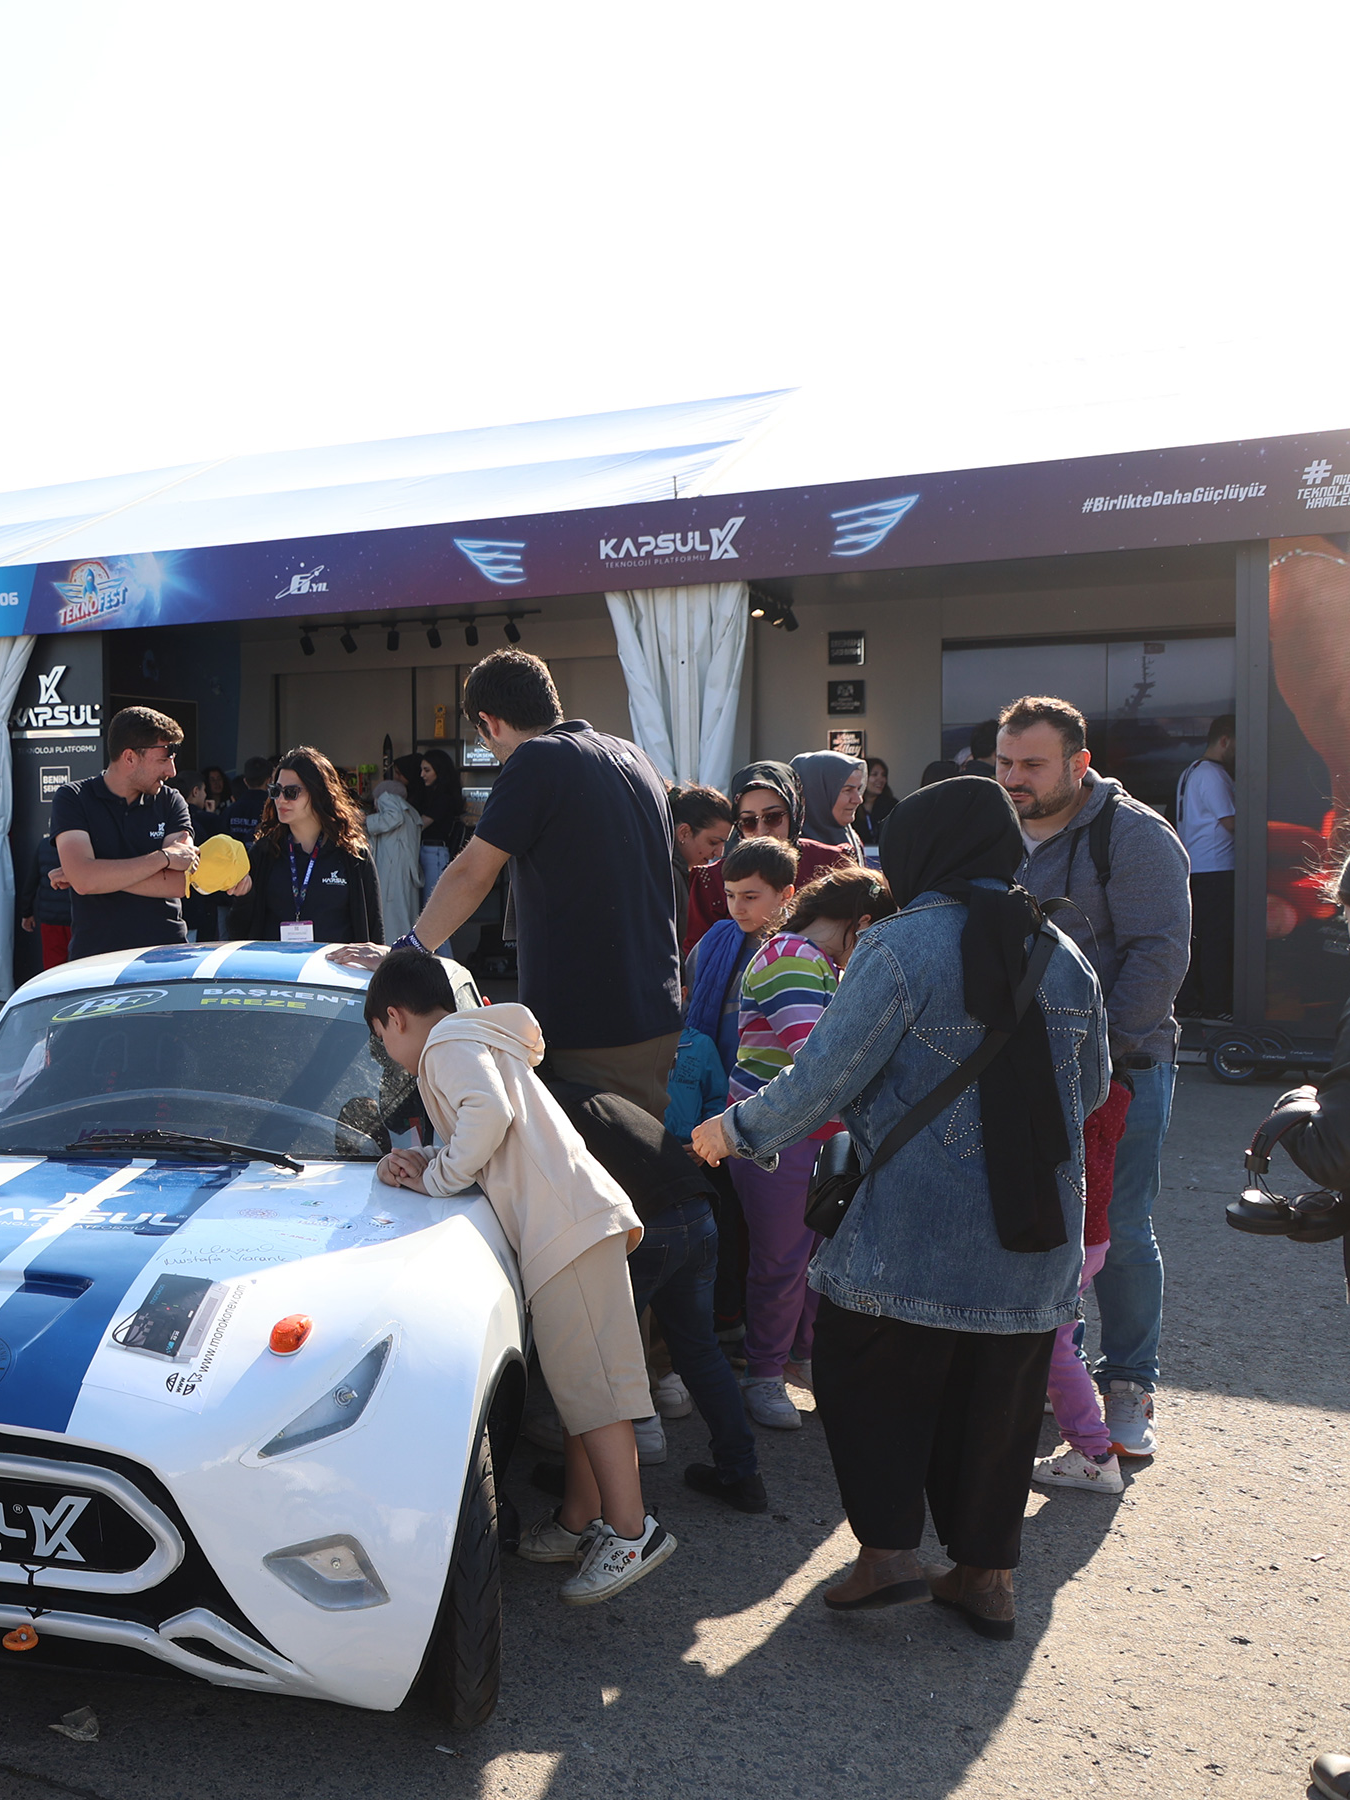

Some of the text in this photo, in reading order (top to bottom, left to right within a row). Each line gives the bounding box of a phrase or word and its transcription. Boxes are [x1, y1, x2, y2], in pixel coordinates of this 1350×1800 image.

[1081, 482, 1267, 514] #BirlikteDahaGüçlüyüz
[1306, 496, 1350, 510] HAMLE
[600, 531, 710, 560] KAPSUL
[654, 554, 706, 566] PLATFORMU
[58, 586, 128, 626] TEKNOFEST
[55, 745, 97, 754] PLATFORMU
[200, 998, 307, 1009] FREZE
[203, 988, 362, 1007] BAŞKENT
[74, 1223, 147, 1231] ATFORMU
[199, 1284, 247, 1374] www.monokonev.com
